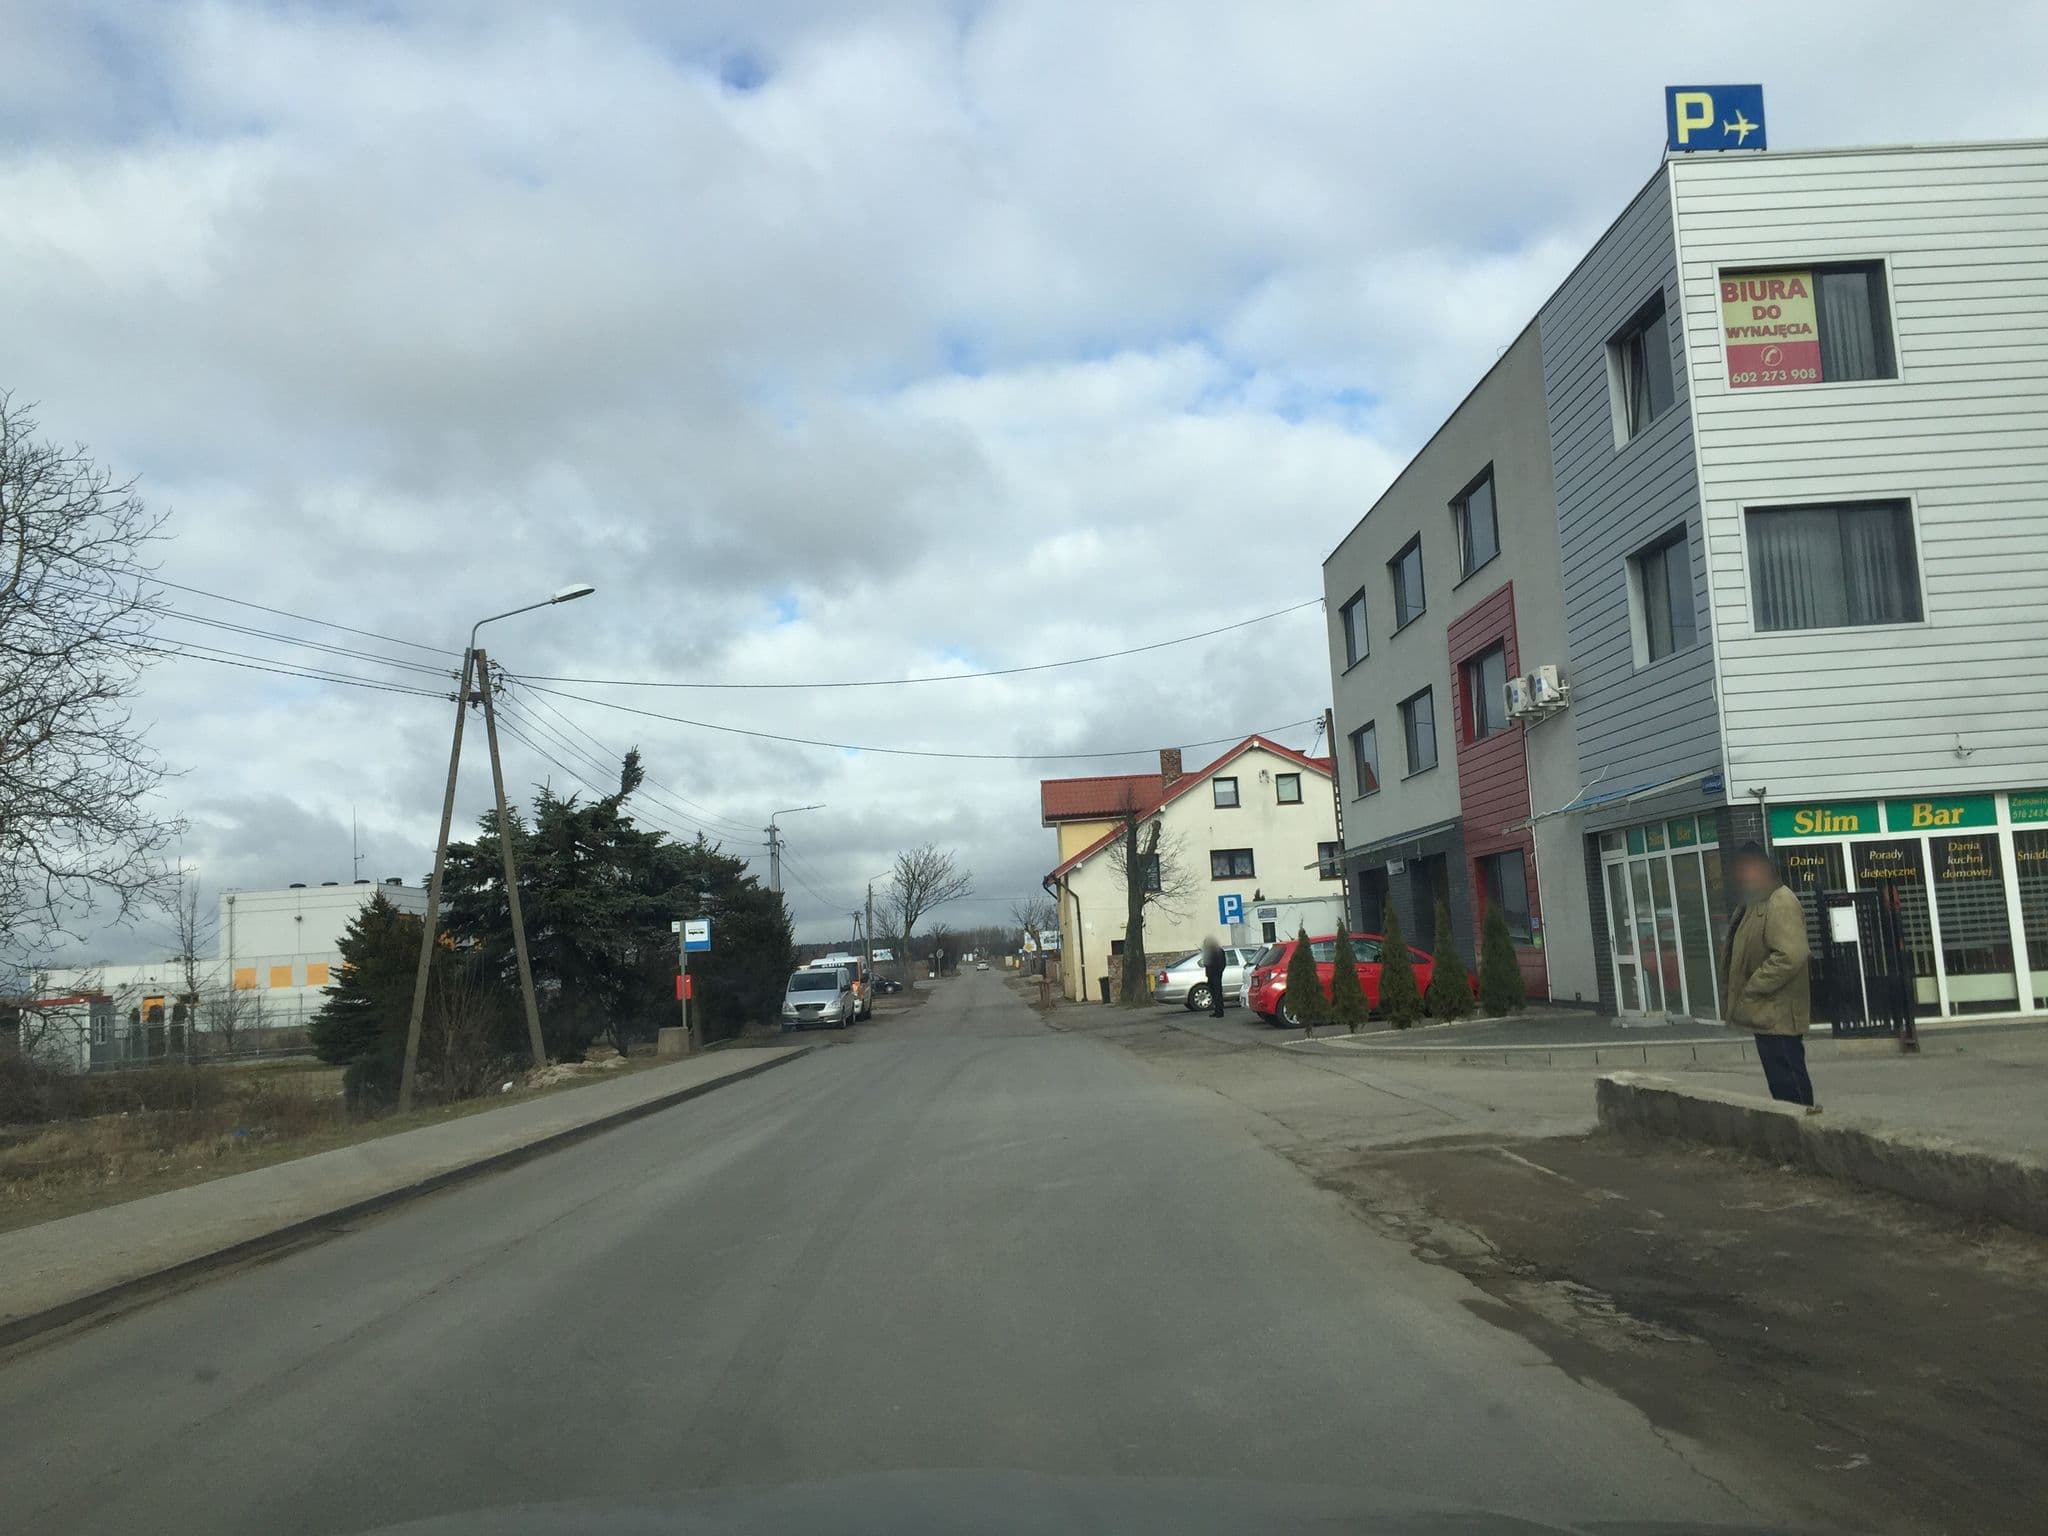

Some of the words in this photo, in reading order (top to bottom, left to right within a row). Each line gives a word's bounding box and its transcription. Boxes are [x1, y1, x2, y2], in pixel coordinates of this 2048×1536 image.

[1675, 92, 1714, 144] P
[1721, 278, 1808, 303] BIURA
[1752, 304, 1781, 321] DO
[1725, 322, 1812, 339] WYNAJĘCIA
[1732, 371, 1757, 384] 602
[1761, 369, 1787, 382] 273
[1791, 368, 1817, 381] 908
[1793, 810, 1859, 834] Slim
[1912, 802, 1964, 827] Bar
[1869, 848, 1903, 861] Porady
[1947, 841, 1980, 852] Dania
[1790, 855, 1824, 866] Dania
[1803, 871, 1815, 882] fit
[1860, 867, 1917, 879] dietetyczne
[1942, 867, 1992, 879] domowej
[1224, 897, 1238, 916] P
